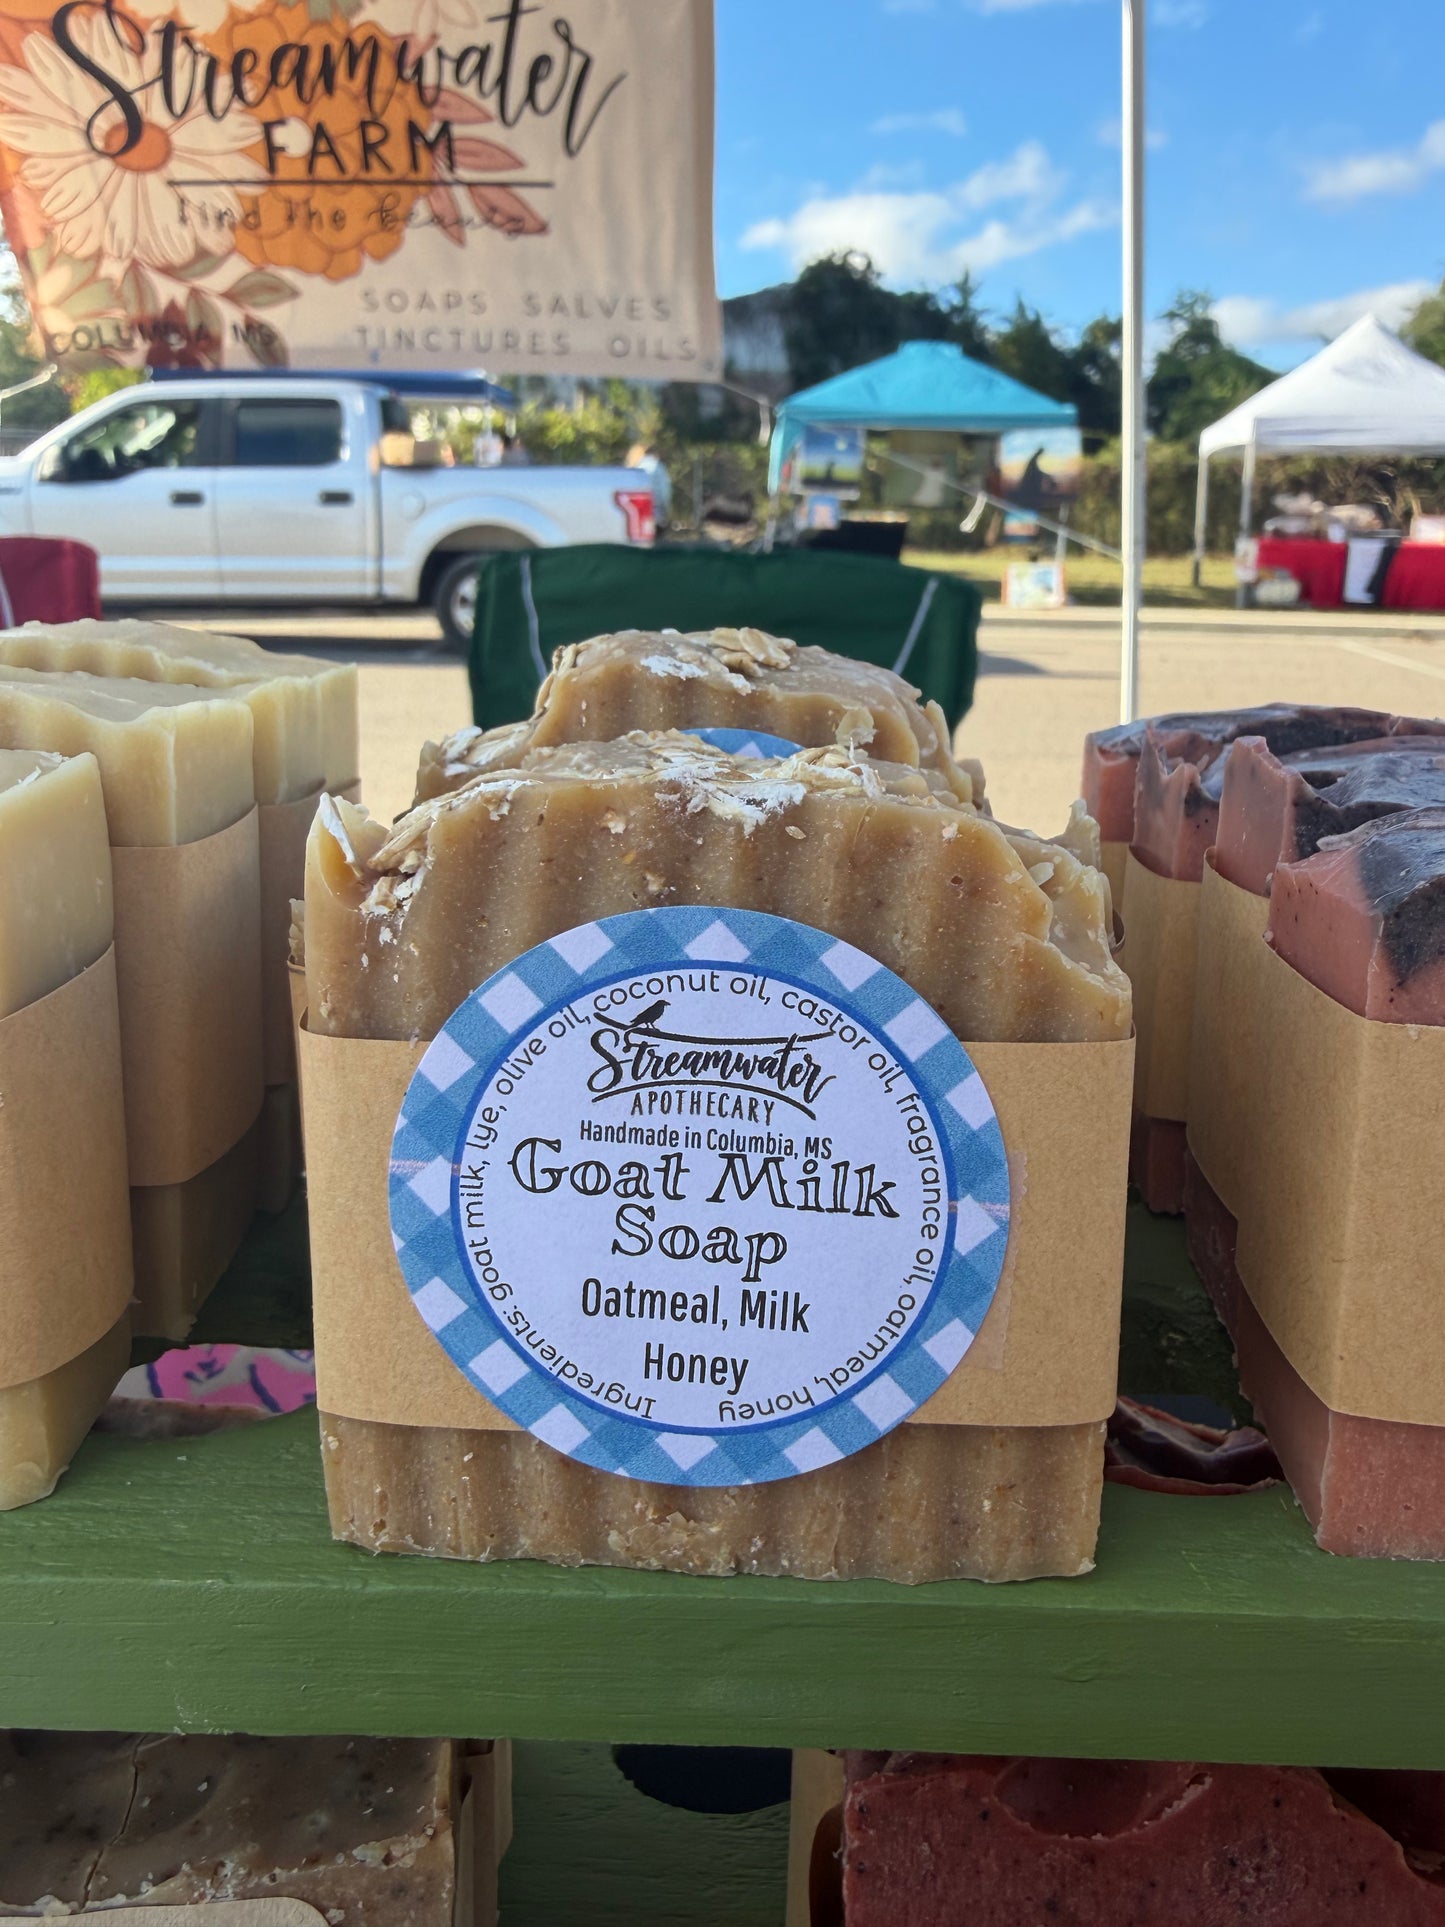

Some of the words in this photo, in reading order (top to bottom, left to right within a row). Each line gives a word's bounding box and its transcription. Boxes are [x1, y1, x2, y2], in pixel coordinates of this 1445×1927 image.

[51, 0, 627, 158] Streamwater
[263, 119, 460, 178] FARM
[362, 287, 488, 316] SOAPS
[523, 292, 672, 322] SALVES
[355, 325, 572, 356] TINCTURES
[606, 334, 697, 362] OILS
[593, 970, 720, 1013] coconut
[729, 973, 771, 1006] oil,
[547, 1003, 592, 1039] oil,
[781, 990, 871, 1050] castor
[495, 1037, 548, 1096] olive
[586, 1026, 837, 1104] Streamwater
[867, 1052, 906, 1094] oil,
[465, 1104, 508, 1150] lye,
[630, 1089, 775, 1127] APOTHECARY
[579, 1119, 680, 1148] Handmade
[684, 1126, 702, 1150] in
[706, 1128, 799, 1161] Columbia,
[804, 1136, 833, 1160] MS
[896, 1092, 942, 1240] fragrance
[459, 1159, 491, 1229] milk,
[507, 1136, 690, 1201] Goat
[704, 1152, 901, 1219] Milk
[468, 1236, 514, 1302] goat
[611, 1202, 788, 1283] Soap
[902, 1247, 937, 1285] oil,
[581, 1277, 728, 1332] Oatmeal,
[739, 1288, 811, 1334] Milk
[503, 1304, 656, 1420] Ingredients:
[643, 1341, 750, 1396] Honey
[813, 1293, 916, 1396] oatmeal,
[718, 1385, 816, 1422] honey
